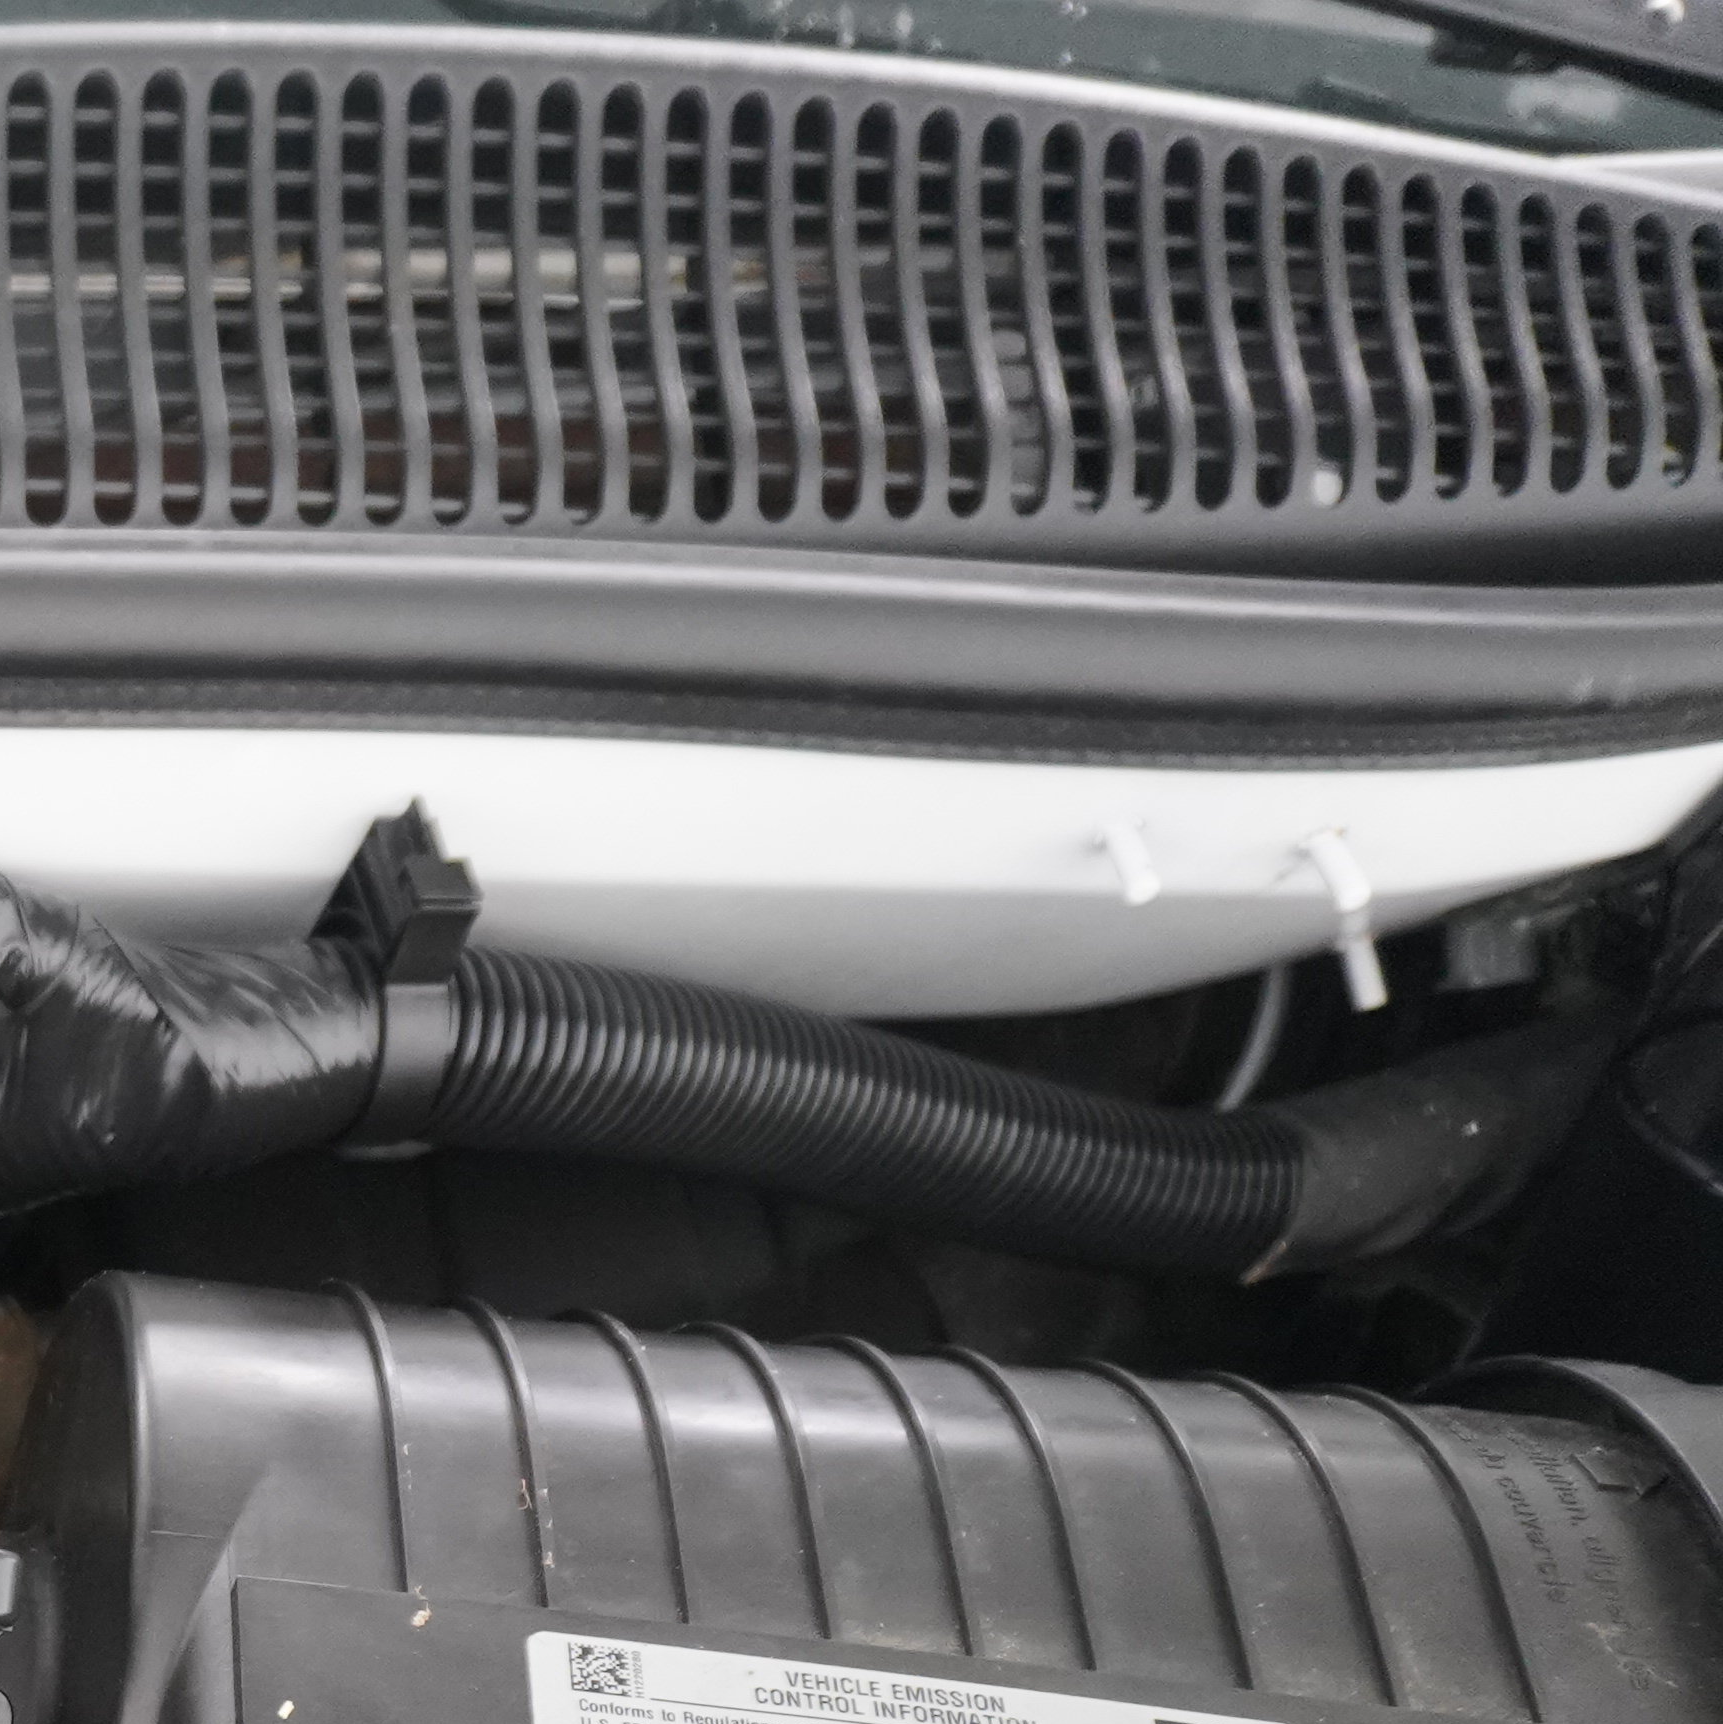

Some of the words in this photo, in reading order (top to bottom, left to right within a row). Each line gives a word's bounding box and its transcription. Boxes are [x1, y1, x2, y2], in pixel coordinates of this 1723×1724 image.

[754, 1687, 865, 1716] CONTROL
[785, 1671, 882, 1698] VEHICLE
[891, 1683, 1005, 1713] EMISSION
[579, 1699, 654, 1720] Conforms
[662, 1709, 676, 1722] to
